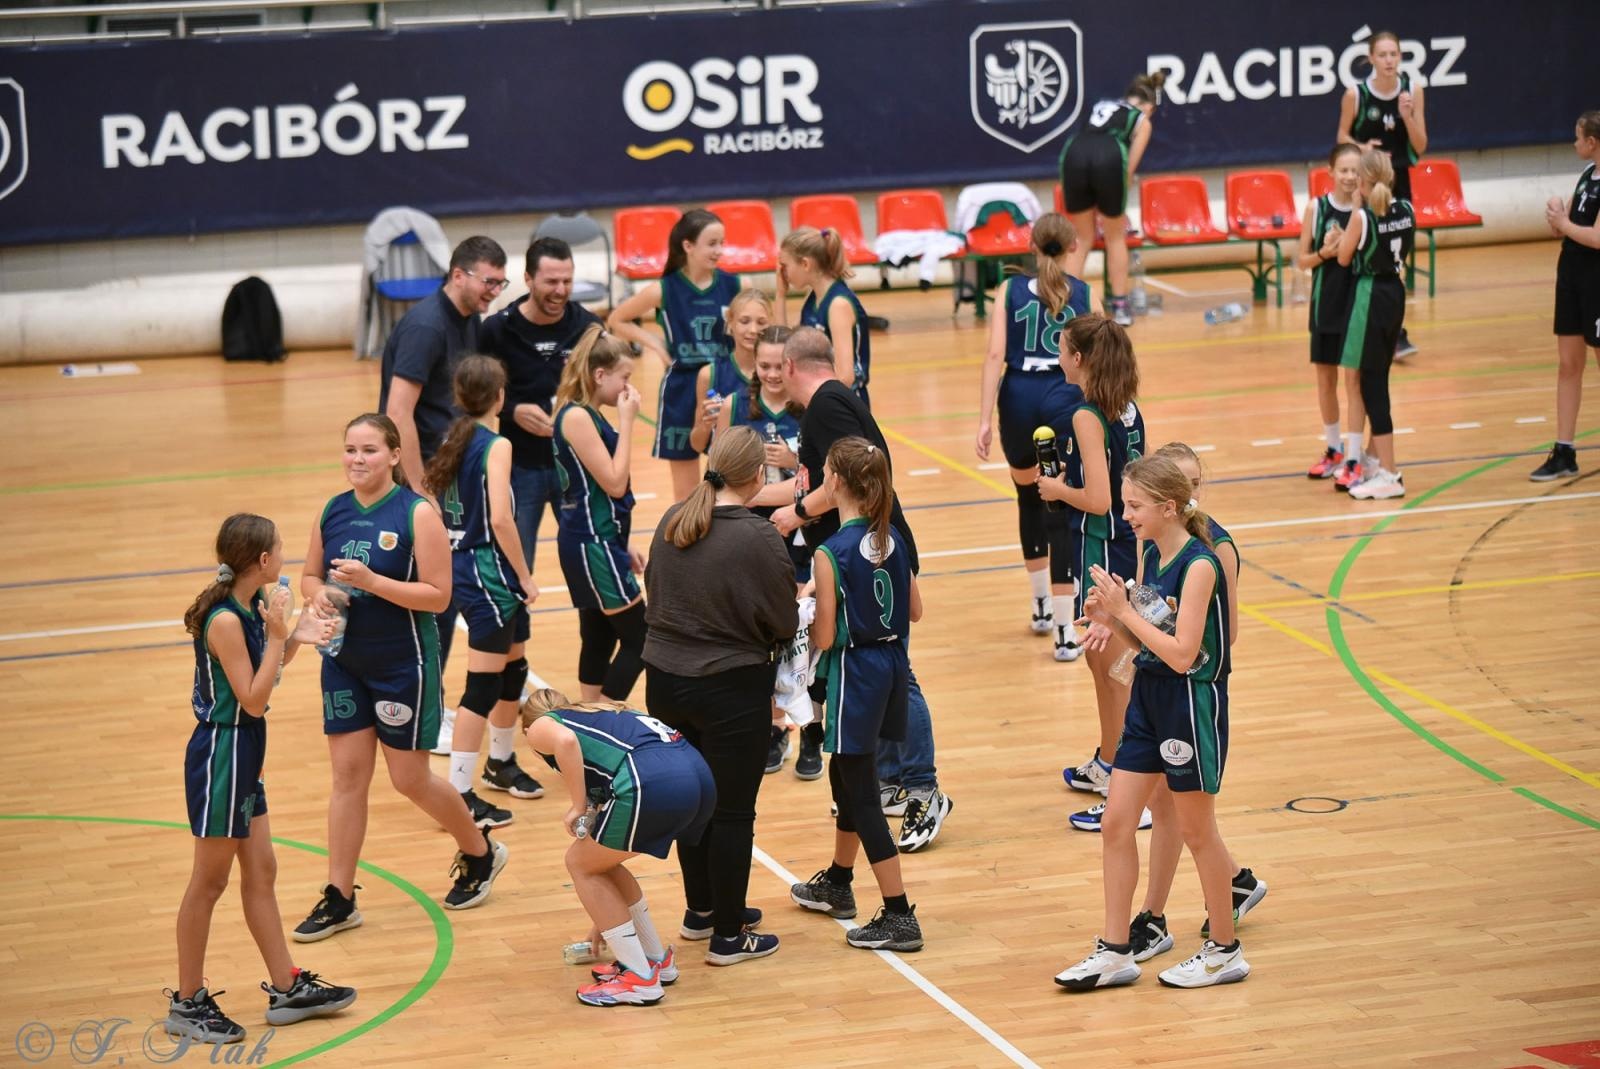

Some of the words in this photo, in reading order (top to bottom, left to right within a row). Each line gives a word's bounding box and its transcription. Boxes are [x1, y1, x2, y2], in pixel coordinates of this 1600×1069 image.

[1146, 24, 1467, 105] RACIBÓRZ
[102, 82, 469, 168] RACIBÓRZ
[704, 126, 824, 155] RACIBÓRZ
[690, 316, 717, 341] 17
[1014, 299, 1076, 355] 18
[663, 426, 691, 450] 17
[341, 540, 372, 566] 15
[323, 689, 357, 720] 15
